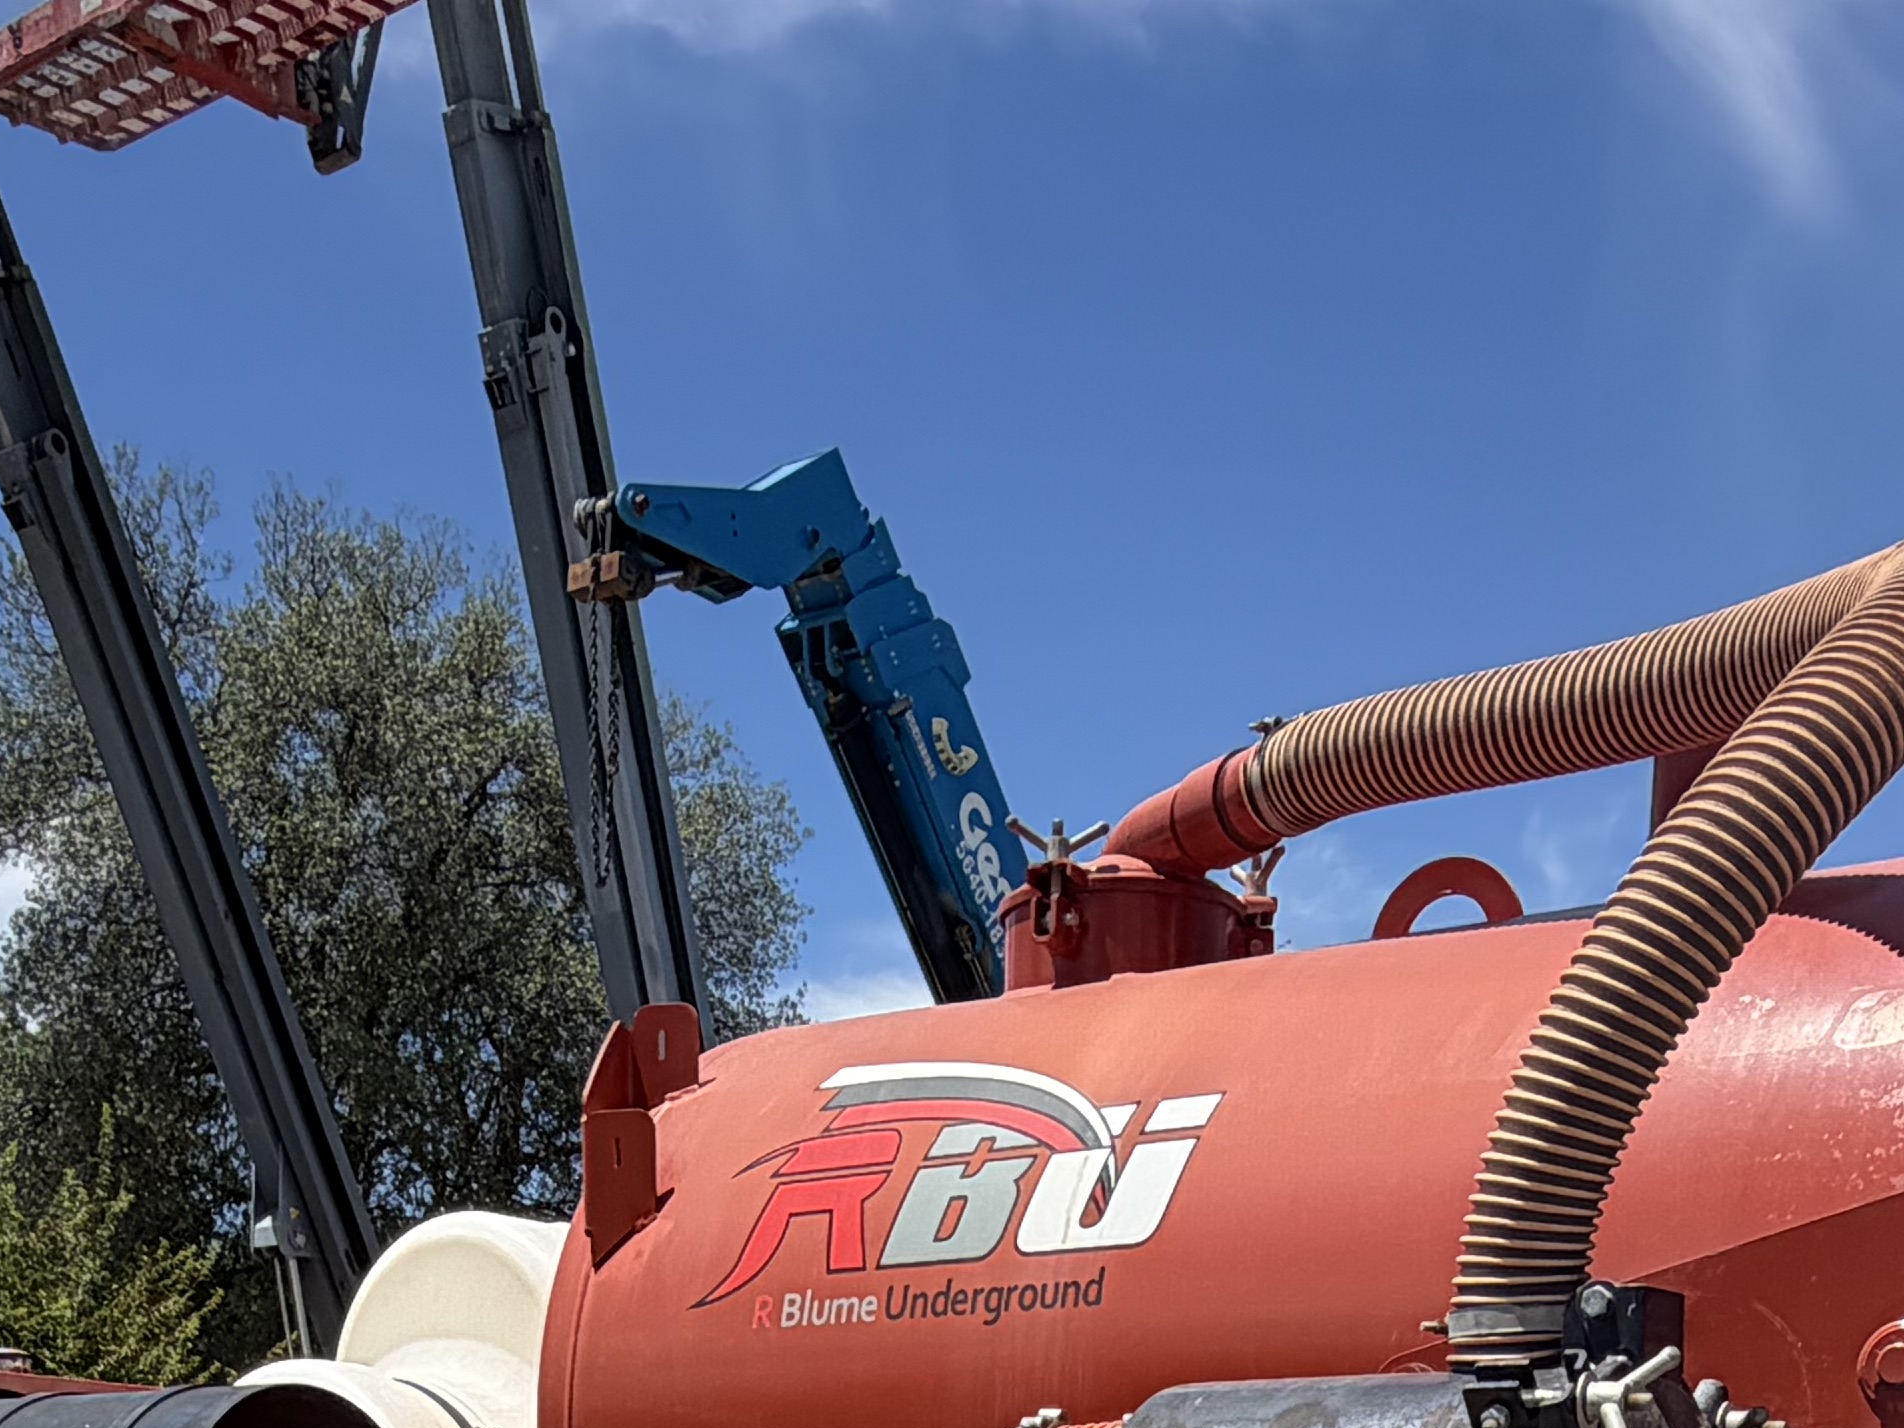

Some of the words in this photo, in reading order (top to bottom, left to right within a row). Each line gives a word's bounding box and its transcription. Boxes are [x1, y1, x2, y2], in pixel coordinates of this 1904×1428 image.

[687, 1062, 1225, 1310] RBU
[751, 1294, 773, 1330] R
[781, 1292, 878, 1328] Blume
[885, 1267, 1106, 1326] Underground
